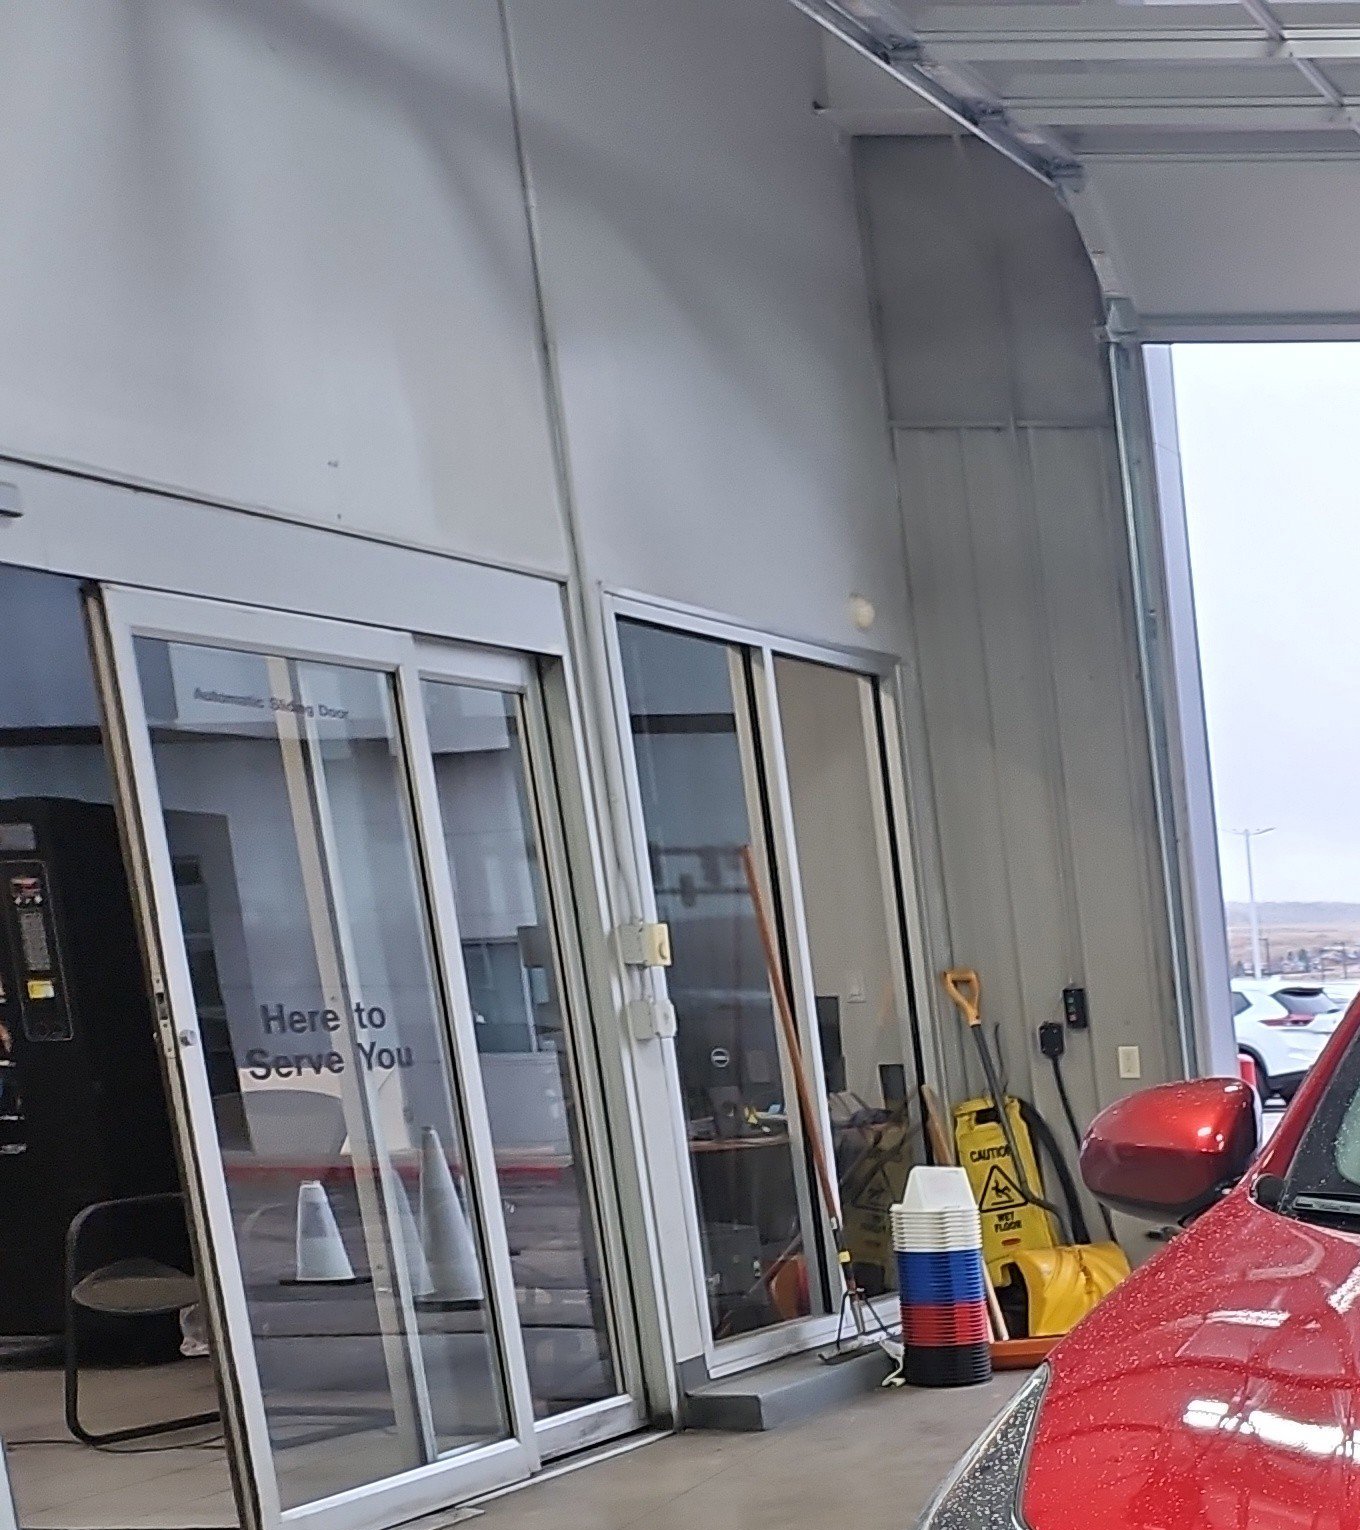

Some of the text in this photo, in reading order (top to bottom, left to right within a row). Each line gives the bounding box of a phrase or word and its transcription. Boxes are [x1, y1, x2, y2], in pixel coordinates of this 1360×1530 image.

[318, 704, 349, 719] Door
[260, 1002, 387, 1034] Here to
[246, 1041, 414, 1081] Serve You
[997, 1211, 1014, 1221] WET
[995, 1220, 1022, 1233] FLOOR
